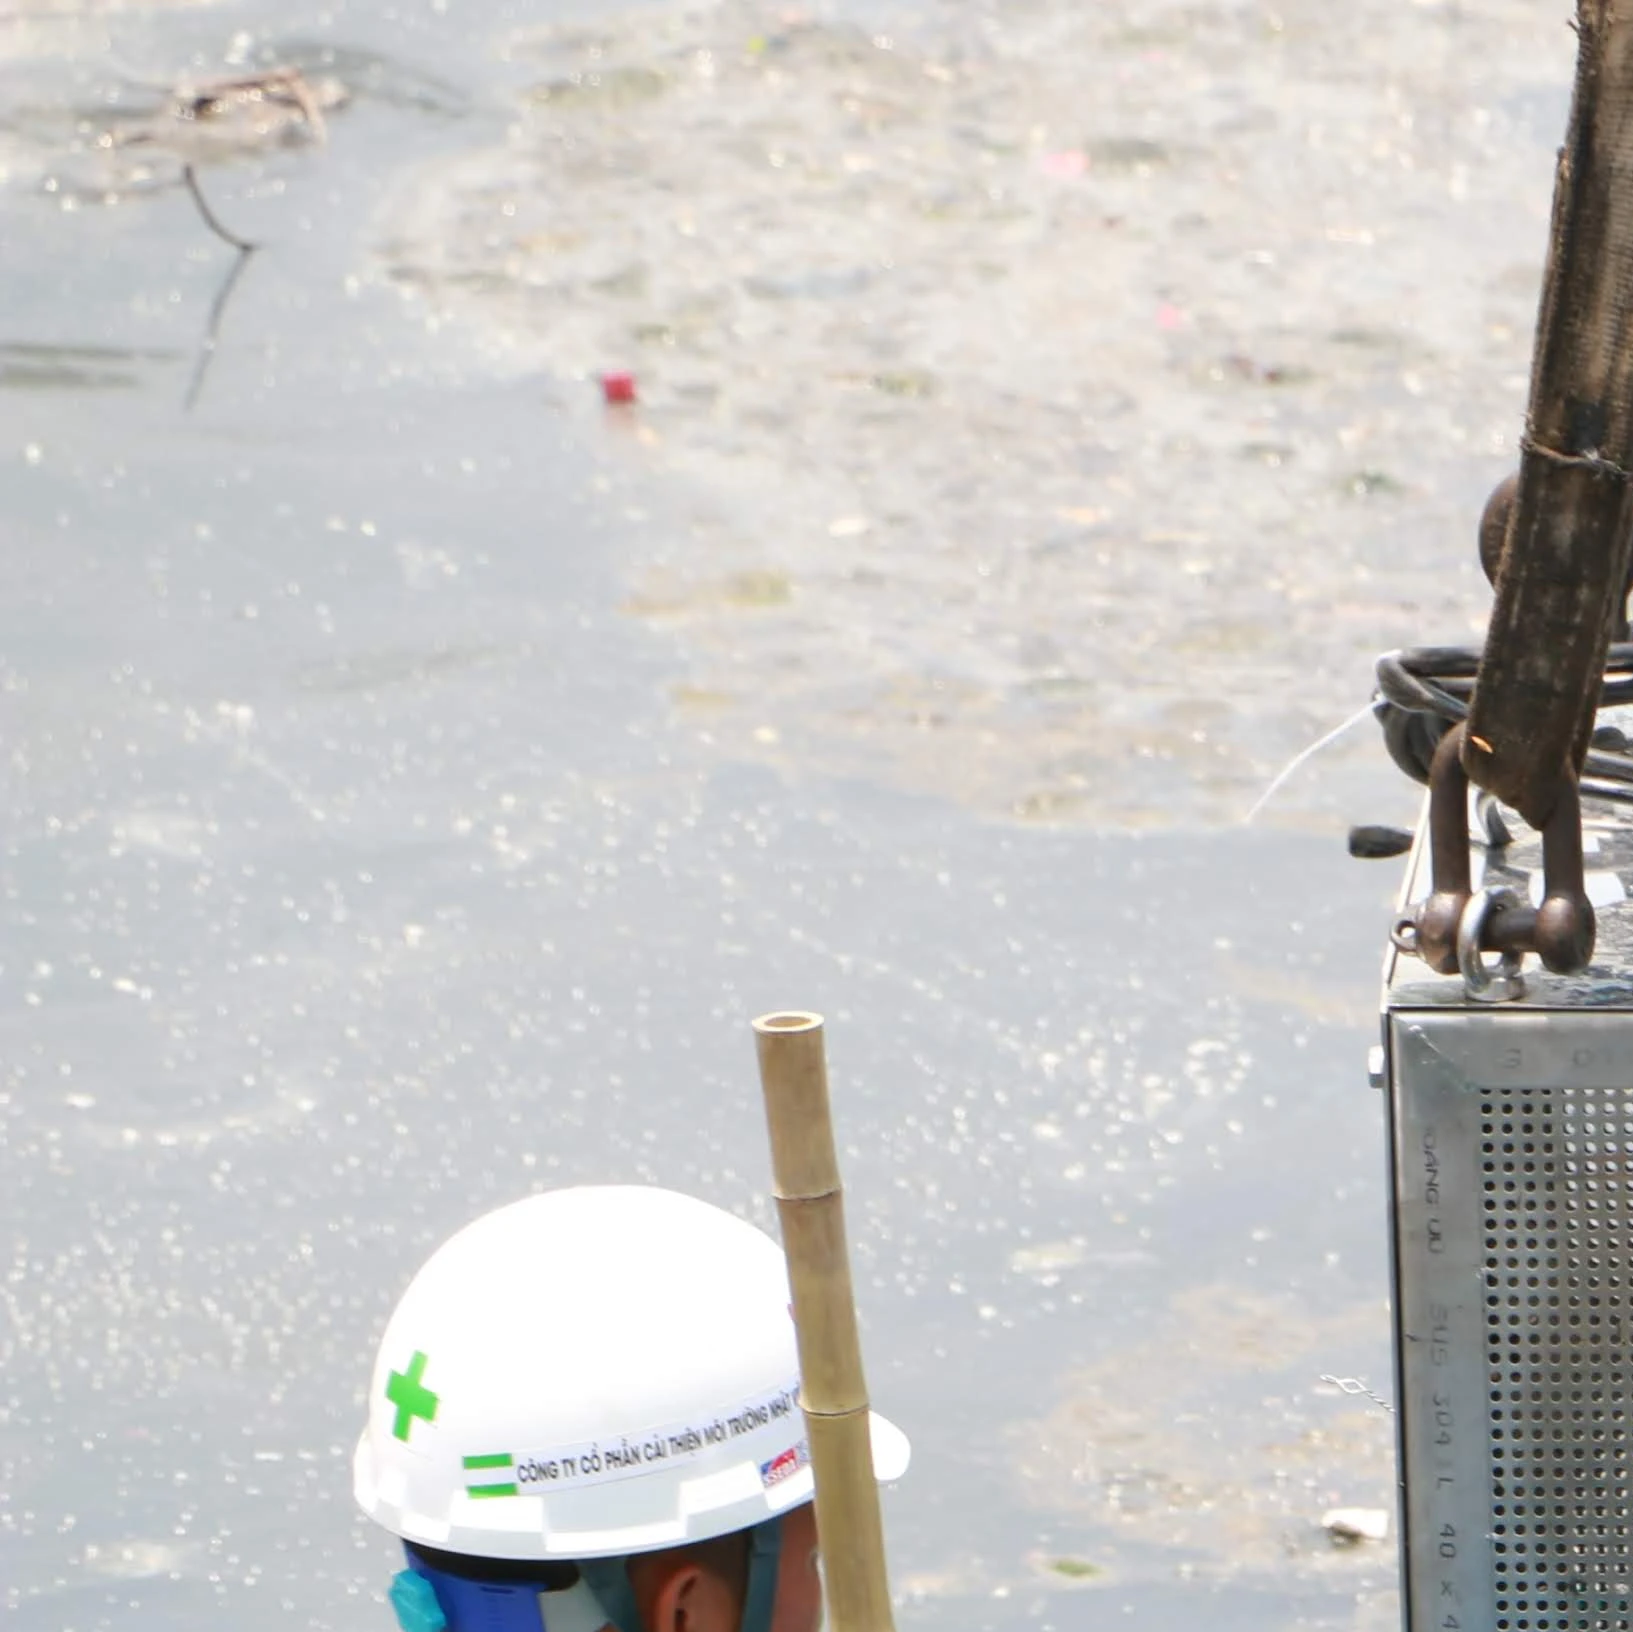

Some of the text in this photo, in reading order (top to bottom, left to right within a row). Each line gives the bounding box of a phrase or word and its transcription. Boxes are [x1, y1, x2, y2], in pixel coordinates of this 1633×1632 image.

[517, 1459, 558, 1483] CÔNG
[562, 1457, 577, 1477] TY
[579, 1442, 601, 1475] CỔ
[1439, 1523, 1457, 1560] 40
